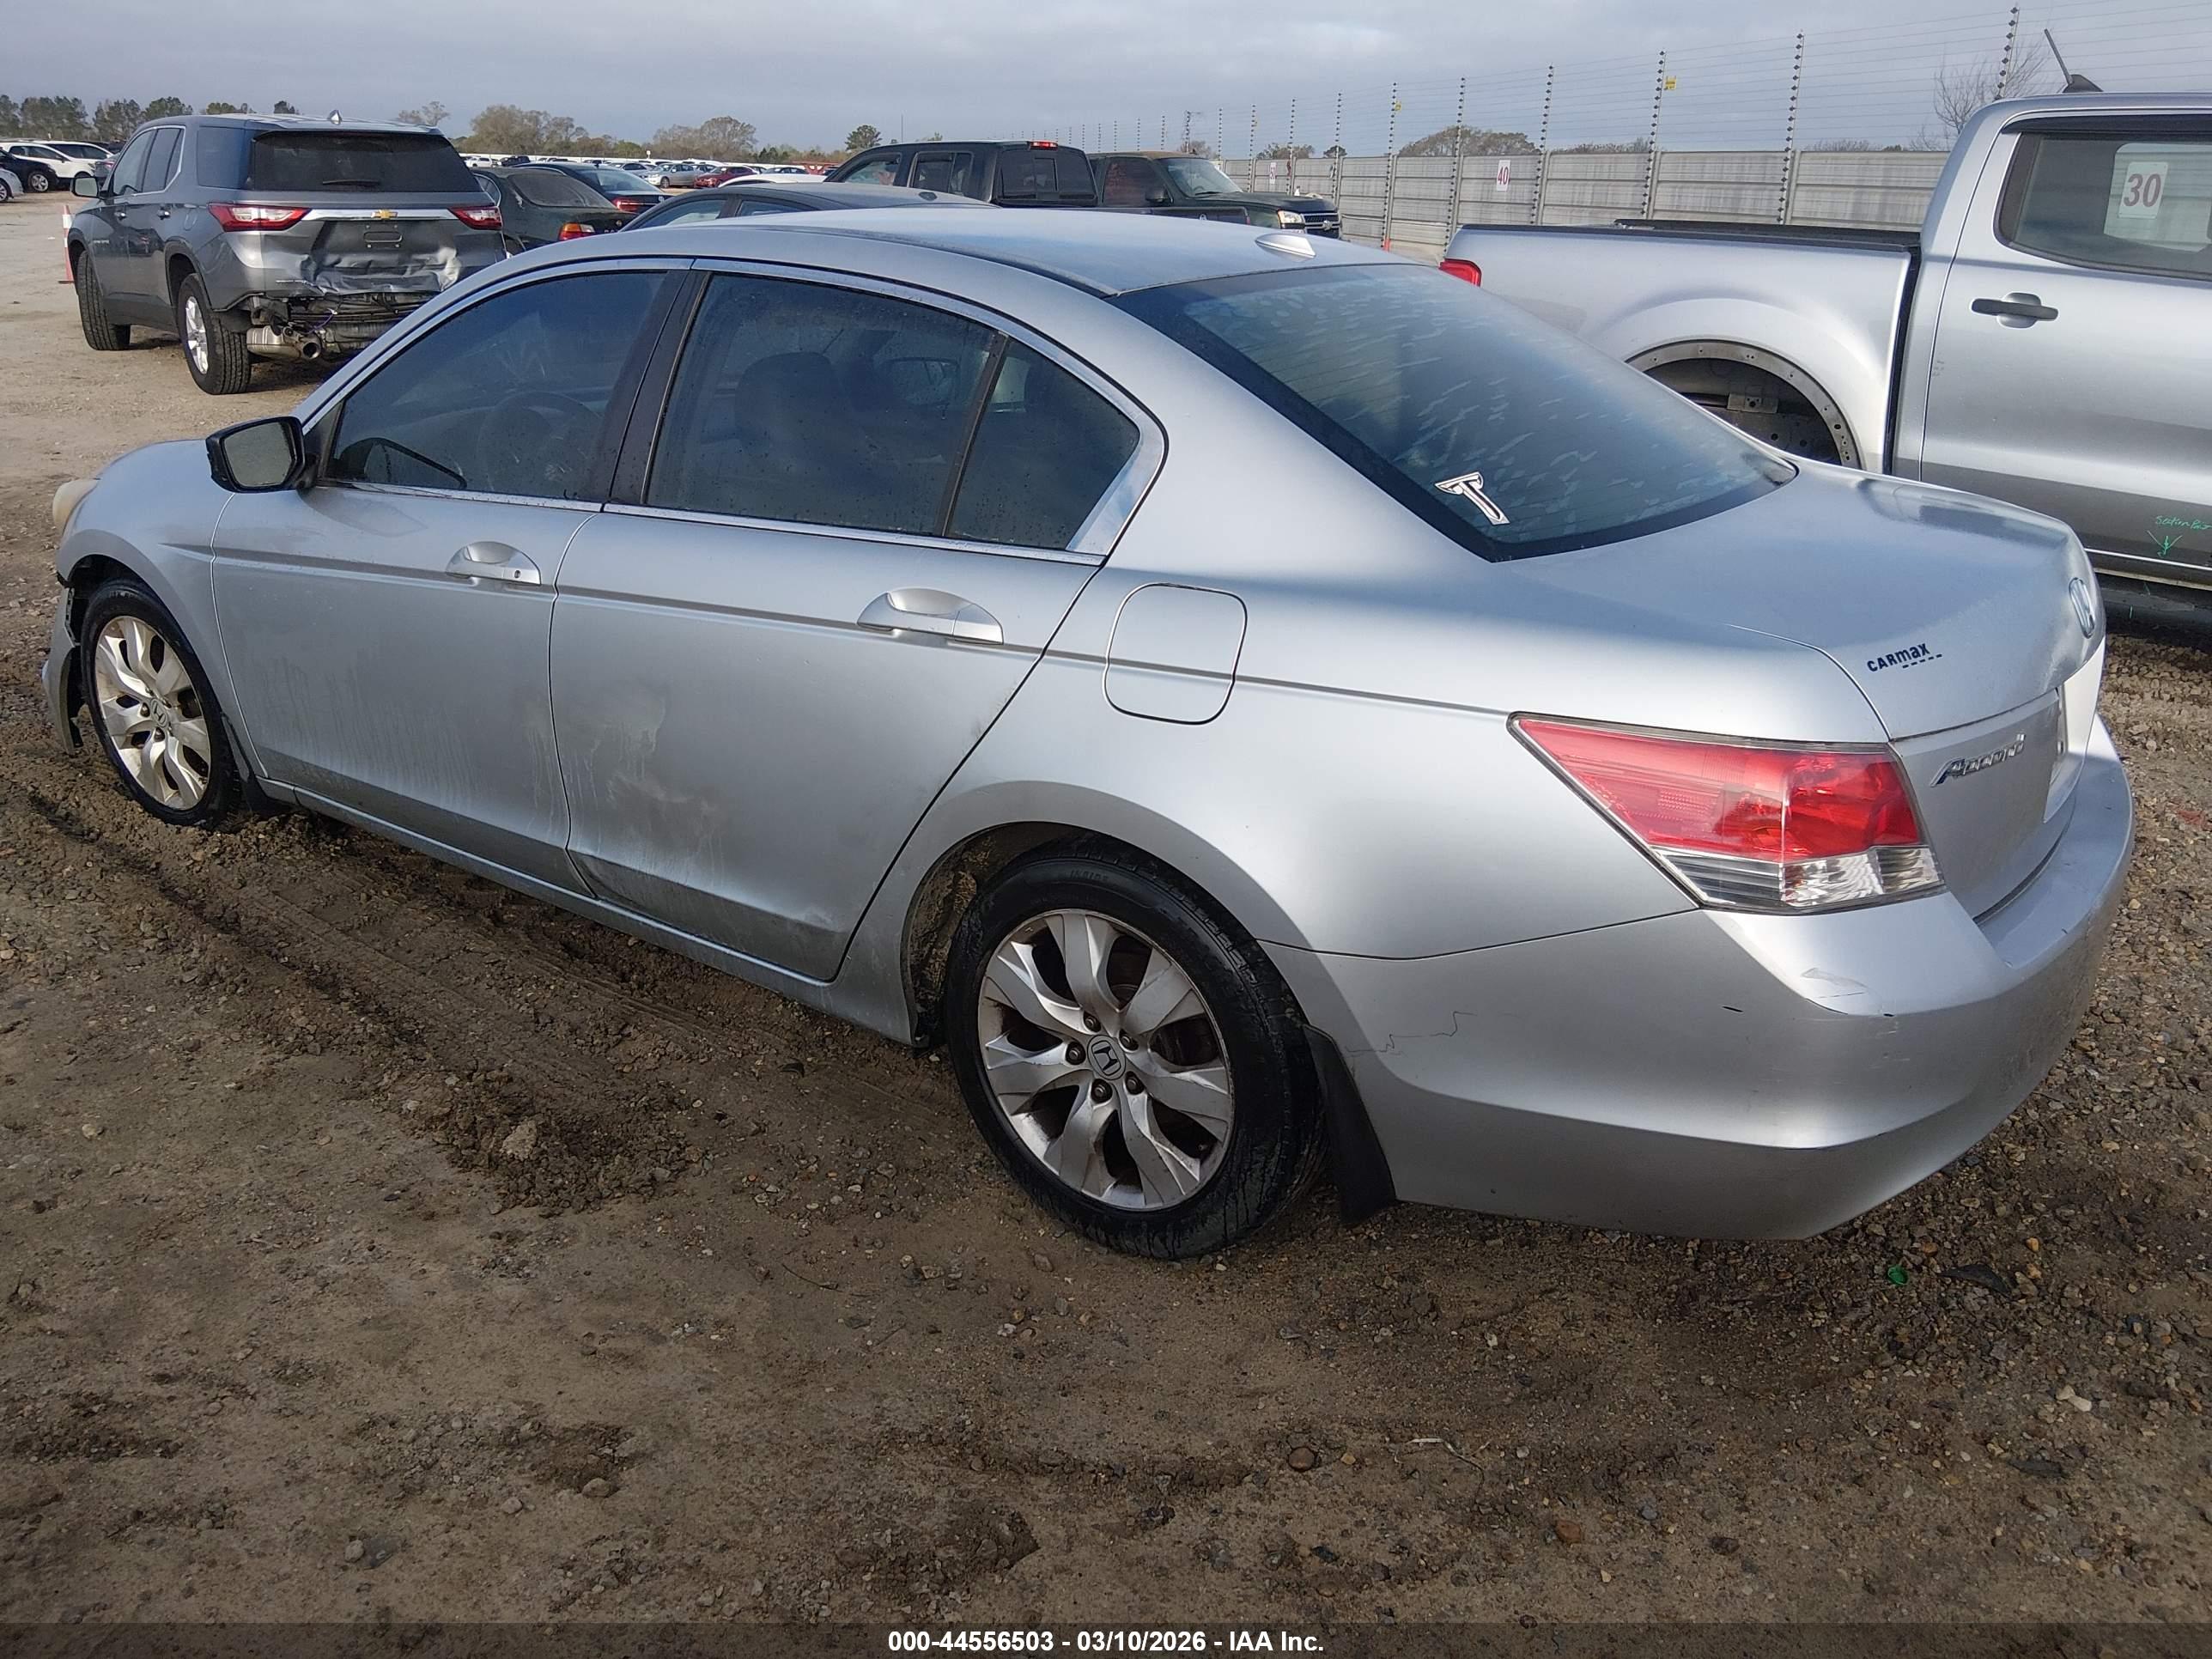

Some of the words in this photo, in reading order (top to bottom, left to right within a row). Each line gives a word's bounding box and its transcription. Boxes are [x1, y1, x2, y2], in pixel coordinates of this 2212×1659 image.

[1498, 166, 1509, 185] 40
[2124, 173, 2162, 208] 30
[1929, 732, 2027, 788] Accord
